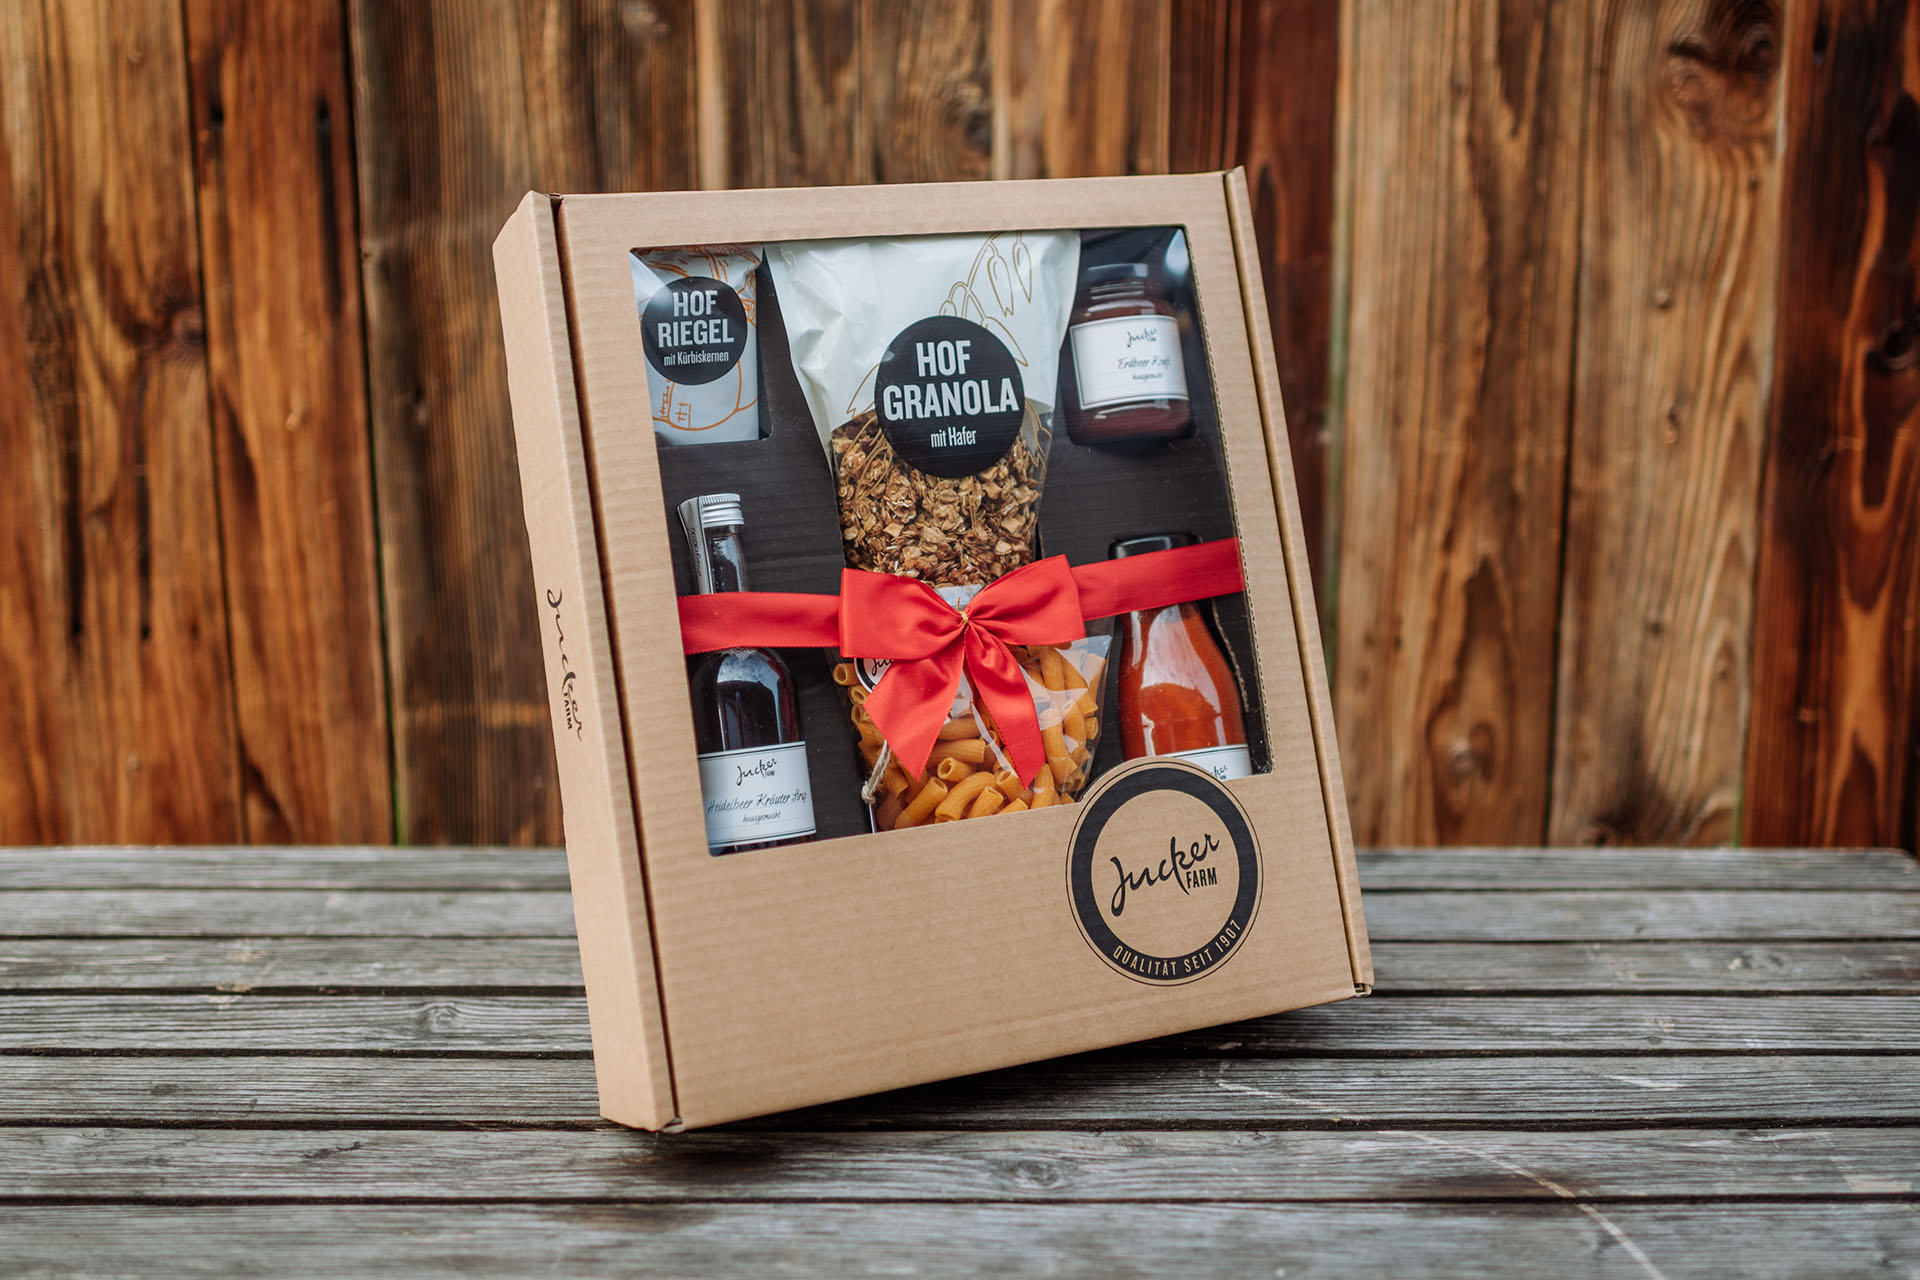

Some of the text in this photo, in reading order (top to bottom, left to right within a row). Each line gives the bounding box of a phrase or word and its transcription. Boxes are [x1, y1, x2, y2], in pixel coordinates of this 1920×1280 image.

[673, 290, 718, 317] HOF
[657, 319, 735, 348] RIEGEL
[663, 350, 729, 366] mit Kürbiskernen
[916, 340, 971, 377] HOF
[883, 378, 1020, 421] GRANOLA
[931, 426, 977, 448] mit Hafer
[547, 589, 582, 741] Jucker
[736, 758, 777, 786] Jucker
[707, 799, 754, 814] Heidelbeer
[755, 793, 791, 807] Kräuter
[1110, 833, 1220, 917] Jucker
[1186, 867, 1217, 889] FARM
[1113, 920, 1242, 976] QUALITÄT SEIT 1907
